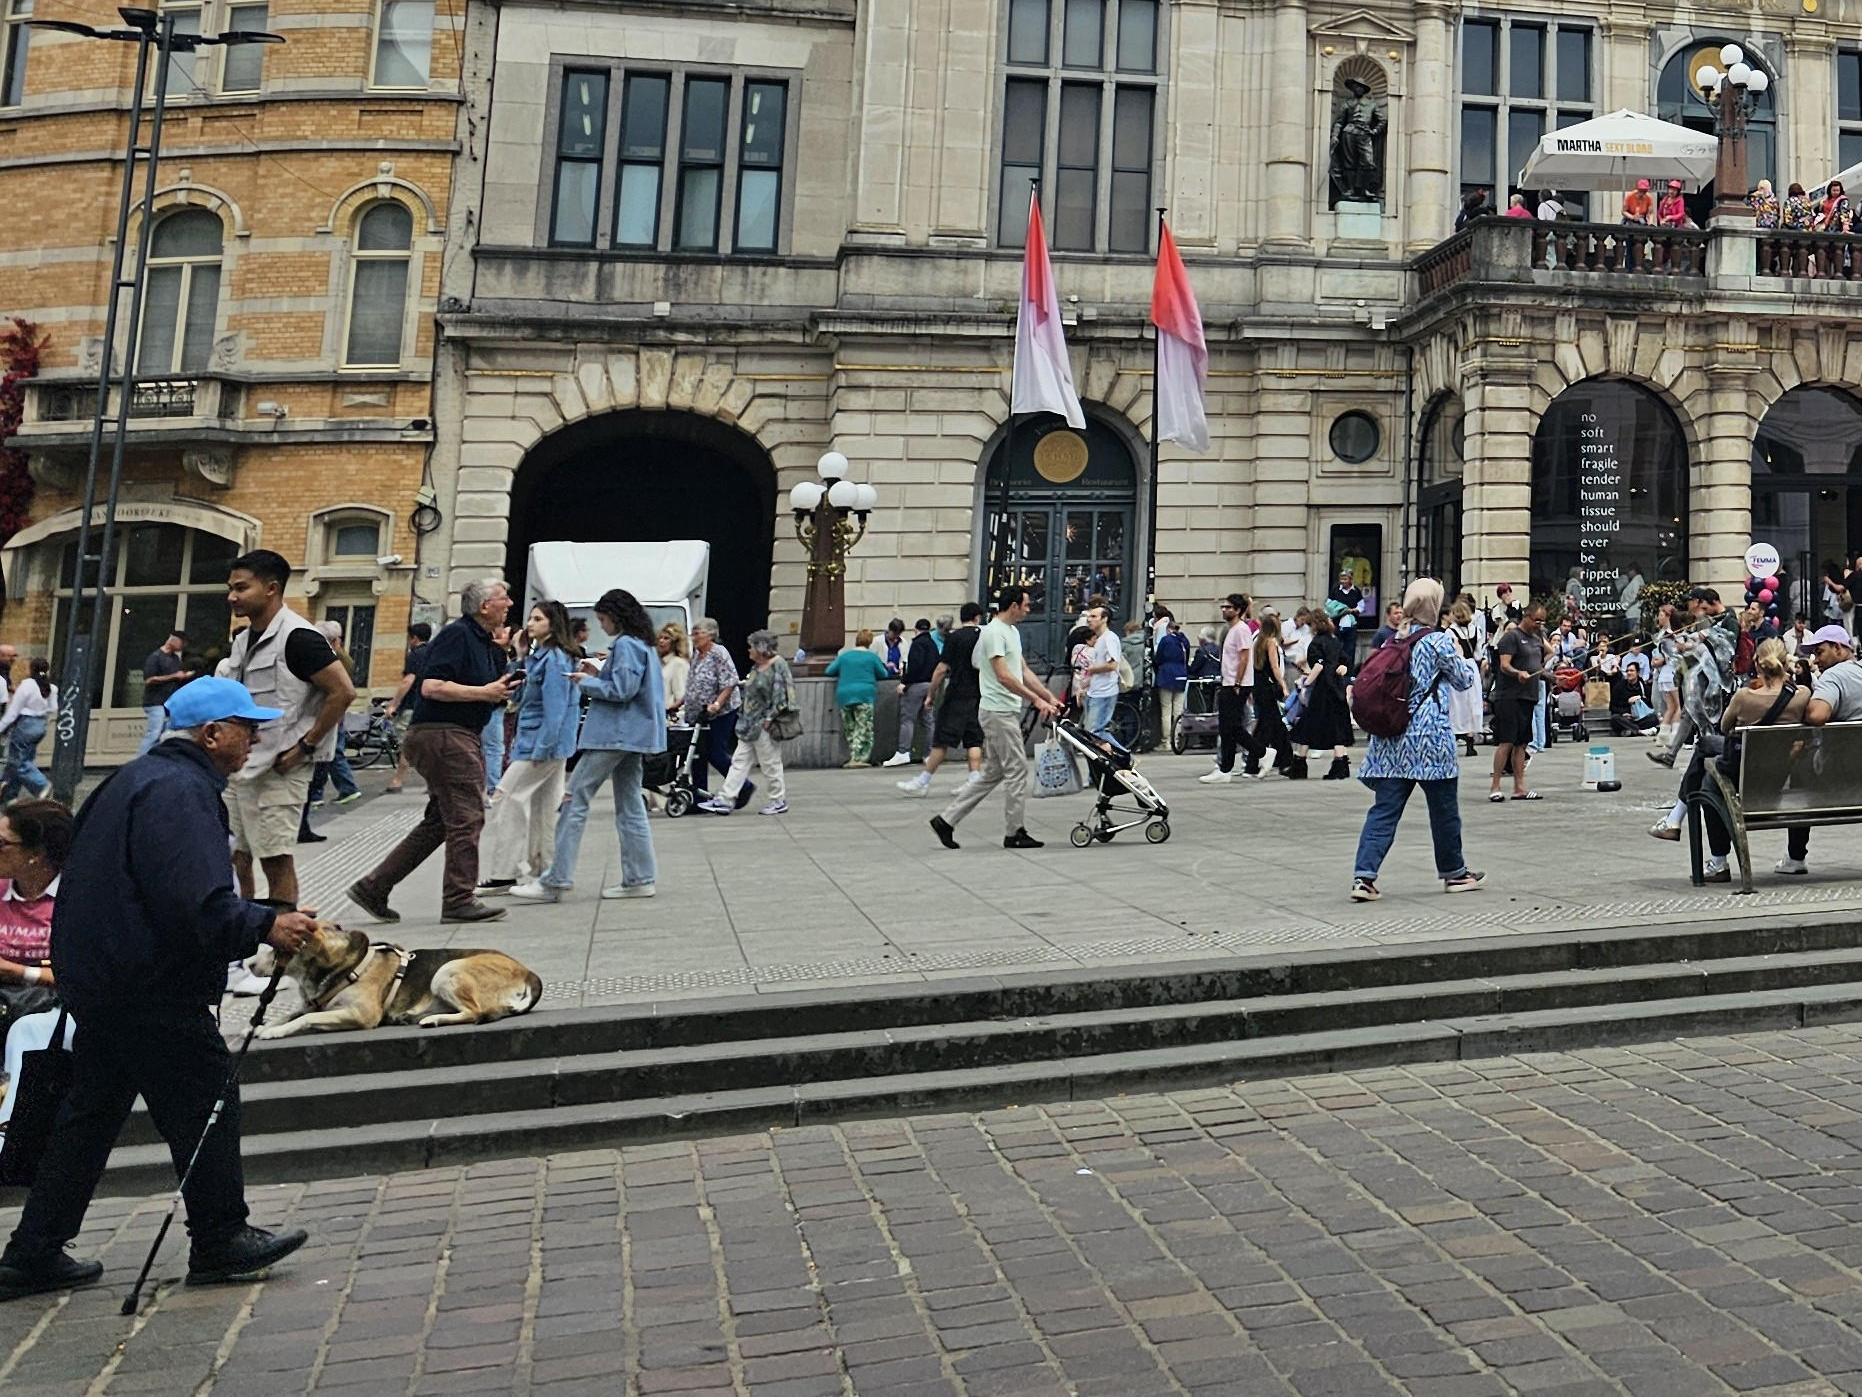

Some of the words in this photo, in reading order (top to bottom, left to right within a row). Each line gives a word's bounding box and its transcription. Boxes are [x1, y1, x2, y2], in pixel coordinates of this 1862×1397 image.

[1557, 139, 1602, 152] MARTHA
[1605, 143, 1624, 152] SEXY
[1581, 414, 1596, 422] no
[1581, 427, 1604, 438] soft
[1581, 444, 1614, 453] smart
[1581, 458, 1619, 472] fragile
[1581, 474, 1621, 485] tender
[1581, 489, 1619, 500] human
[1581, 506, 1616, 516] tissue
[1581, 520, 1620, 532] should
[1580, 539, 1609, 548] ever
[1580, 552, 1595, 563] be
[1580, 568, 1619, 582] ripped
[1580, 586, 1611, 598] apart
[1580, 602, 1629, 612] because
[1579, 618, 1598, 627] we
